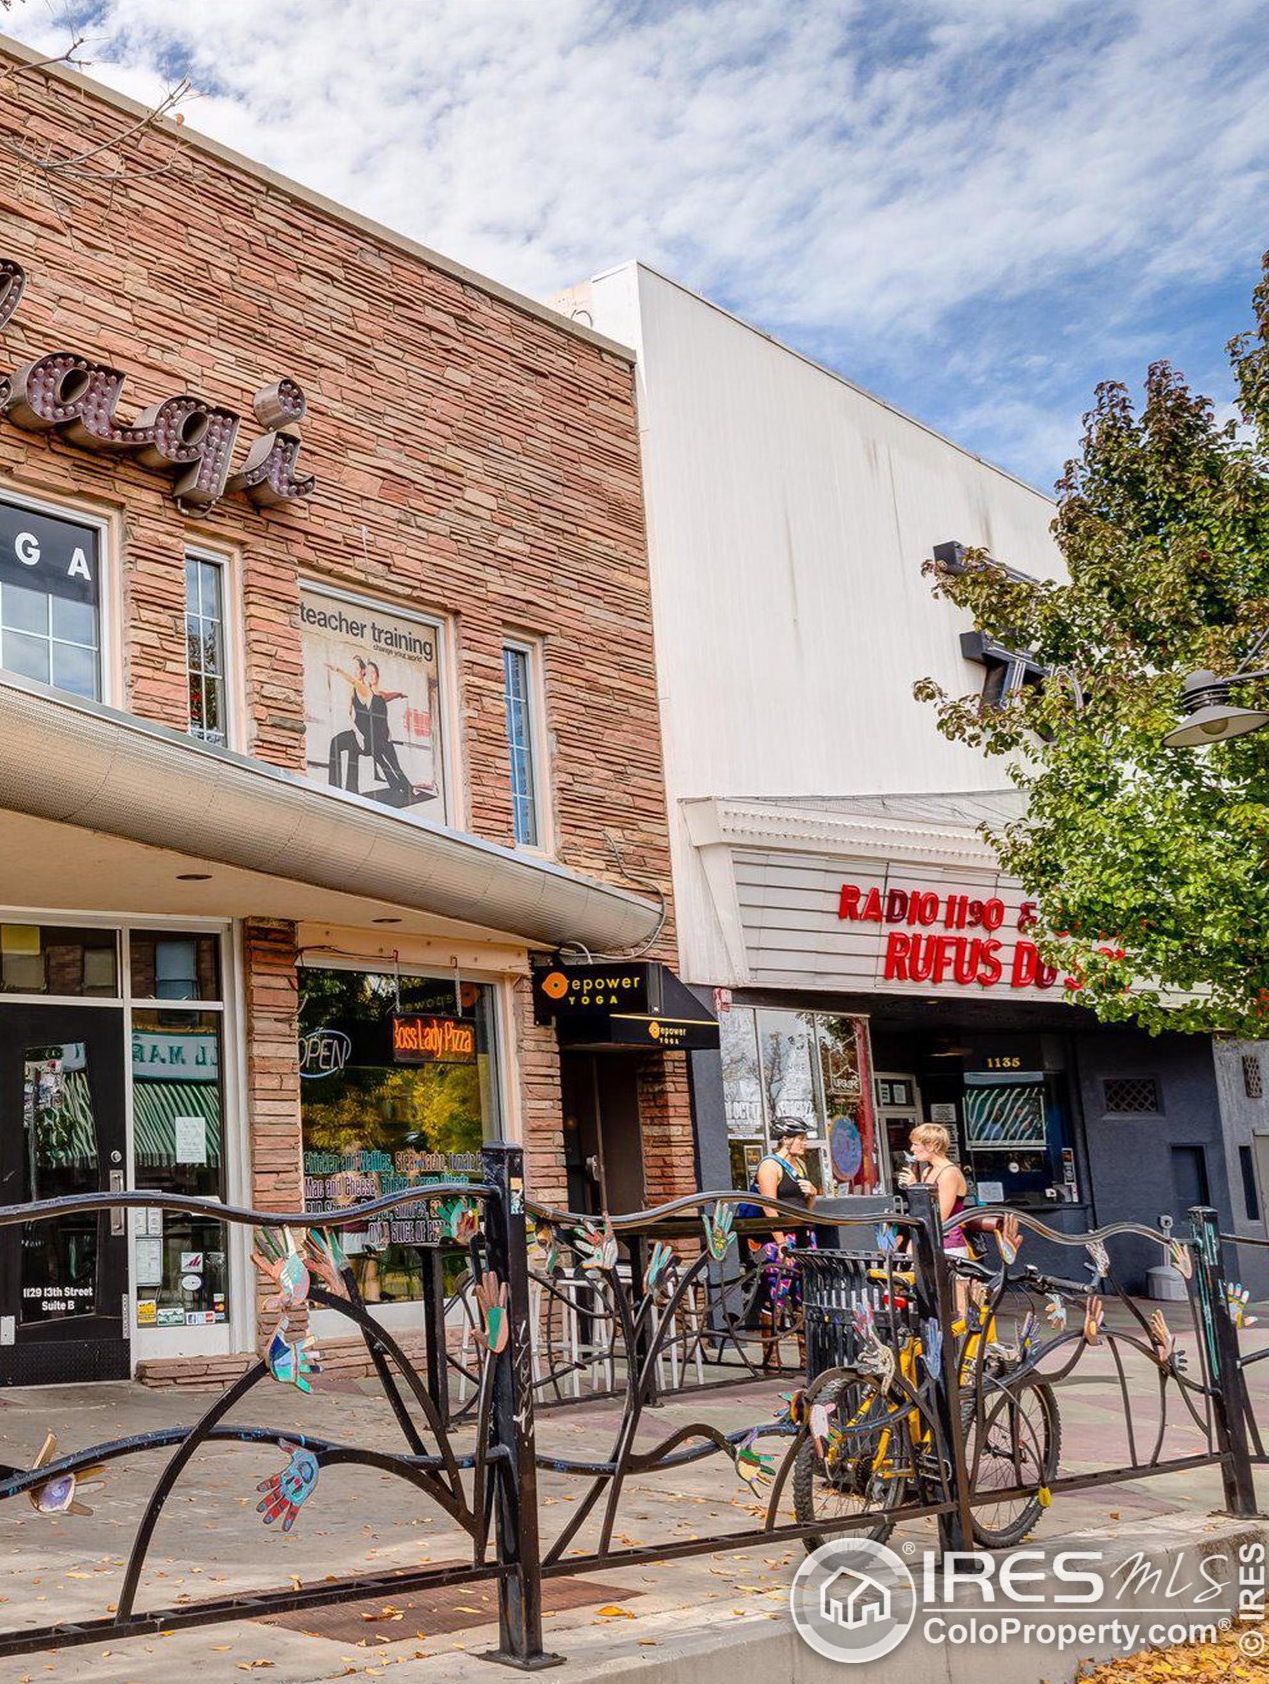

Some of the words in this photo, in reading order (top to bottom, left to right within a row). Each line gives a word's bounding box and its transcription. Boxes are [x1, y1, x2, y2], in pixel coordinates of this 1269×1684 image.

[299, 601, 368, 639] teacher
[371, 621, 434, 662] training
[838, 884, 939, 927] RADIO
[944, 894, 1005, 931] 1190
[884, 931, 1003, 987] RUFUS
[568, 995, 618, 1005] YOGA
[417, 1018, 443, 1058] Lady
[444, 1020, 472, 1053] Pizza
[304, 1175, 325, 1199] Mac
[391, 1220, 414, 1243] SLICE
[415, 1220, 426, 1242] OF
[23, 1287, 43, 1298] 1129
[43, 1287, 63, 1297] 13th
[64, 1286, 93, 1297] Street
[41, 1300, 66, 1311] Suite
[67, 1300, 75, 1310] B
